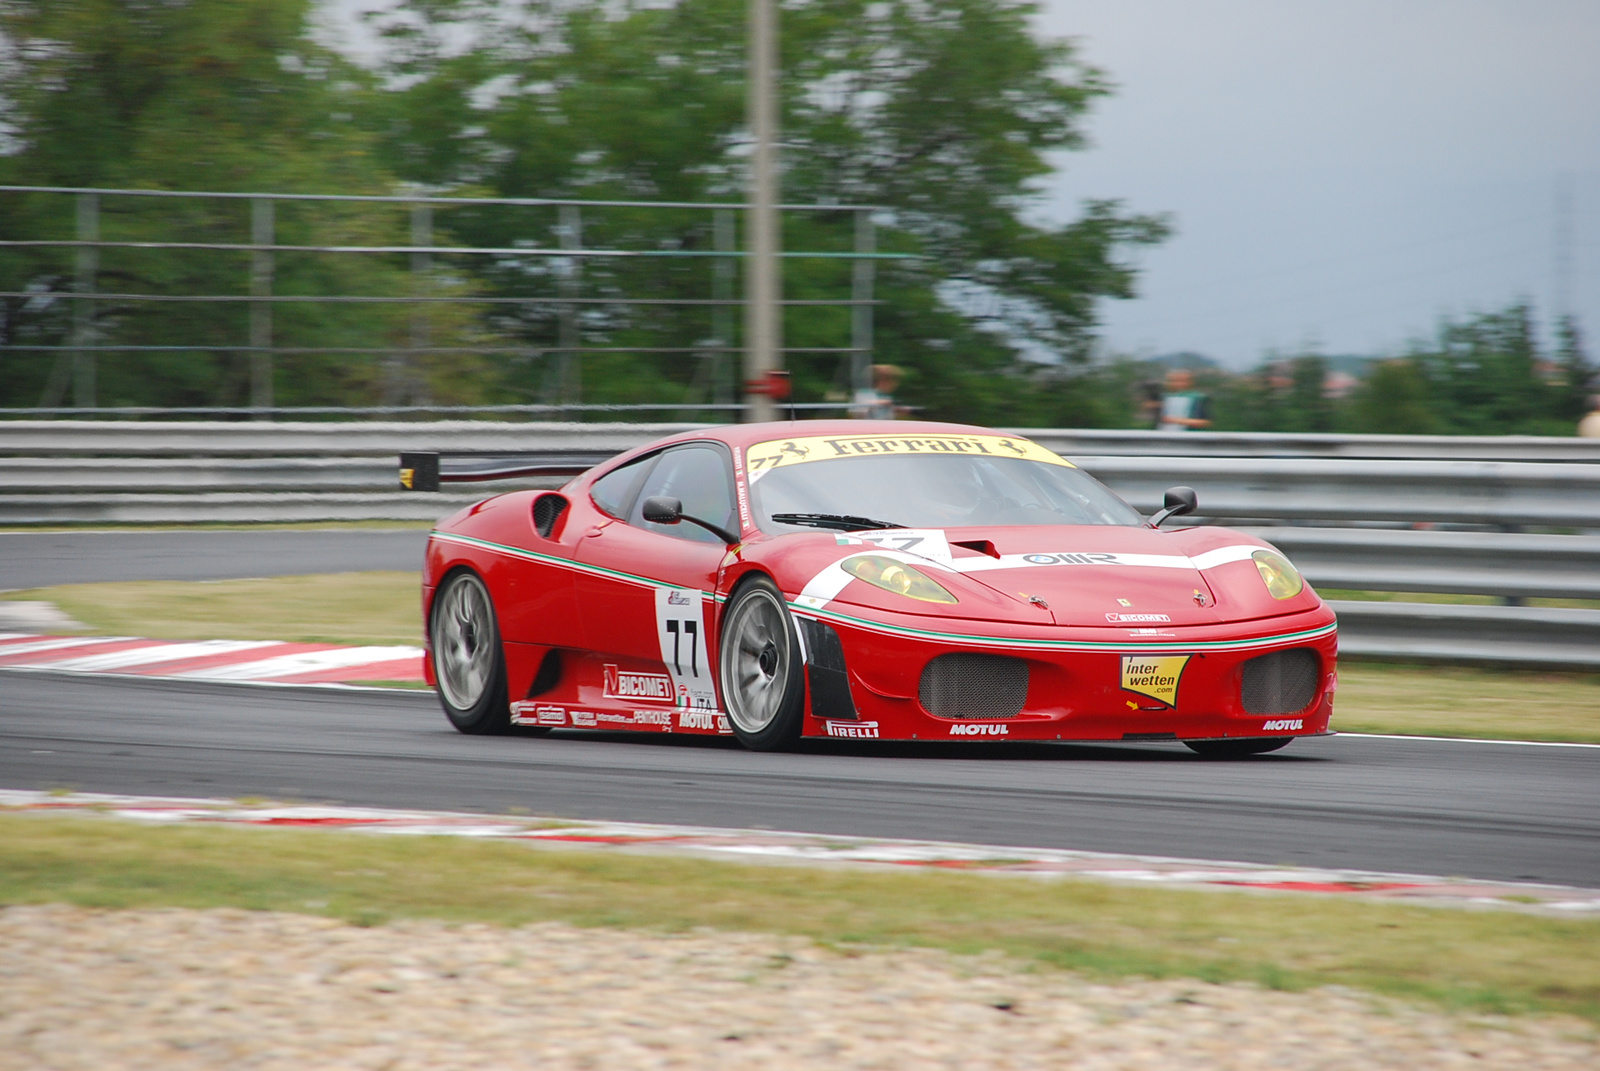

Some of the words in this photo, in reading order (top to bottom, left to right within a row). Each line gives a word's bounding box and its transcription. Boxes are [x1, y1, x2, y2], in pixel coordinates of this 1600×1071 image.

[824, 435, 992, 456] Ferrari
[750, 455, 784, 470] 77
[1119, 614, 1168, 622] BICOMET
[666, 619, 699, 678] 77
[1126, 658, 1158, 675] inter
[618, 675, 671, 698] BICOMET
[1129, 675, 1175, 686] wetten
[1153, 686, 1173, 694] .com
[634, 711, 672, 725] PENTHOUSE
[679, 713, 714, 730] MOTUL
[1263, 719, 1303, 730] MOTUL
[826, 720, 879, 738] PIRELLI
[949, 724, 1009, 736] MOTUL
